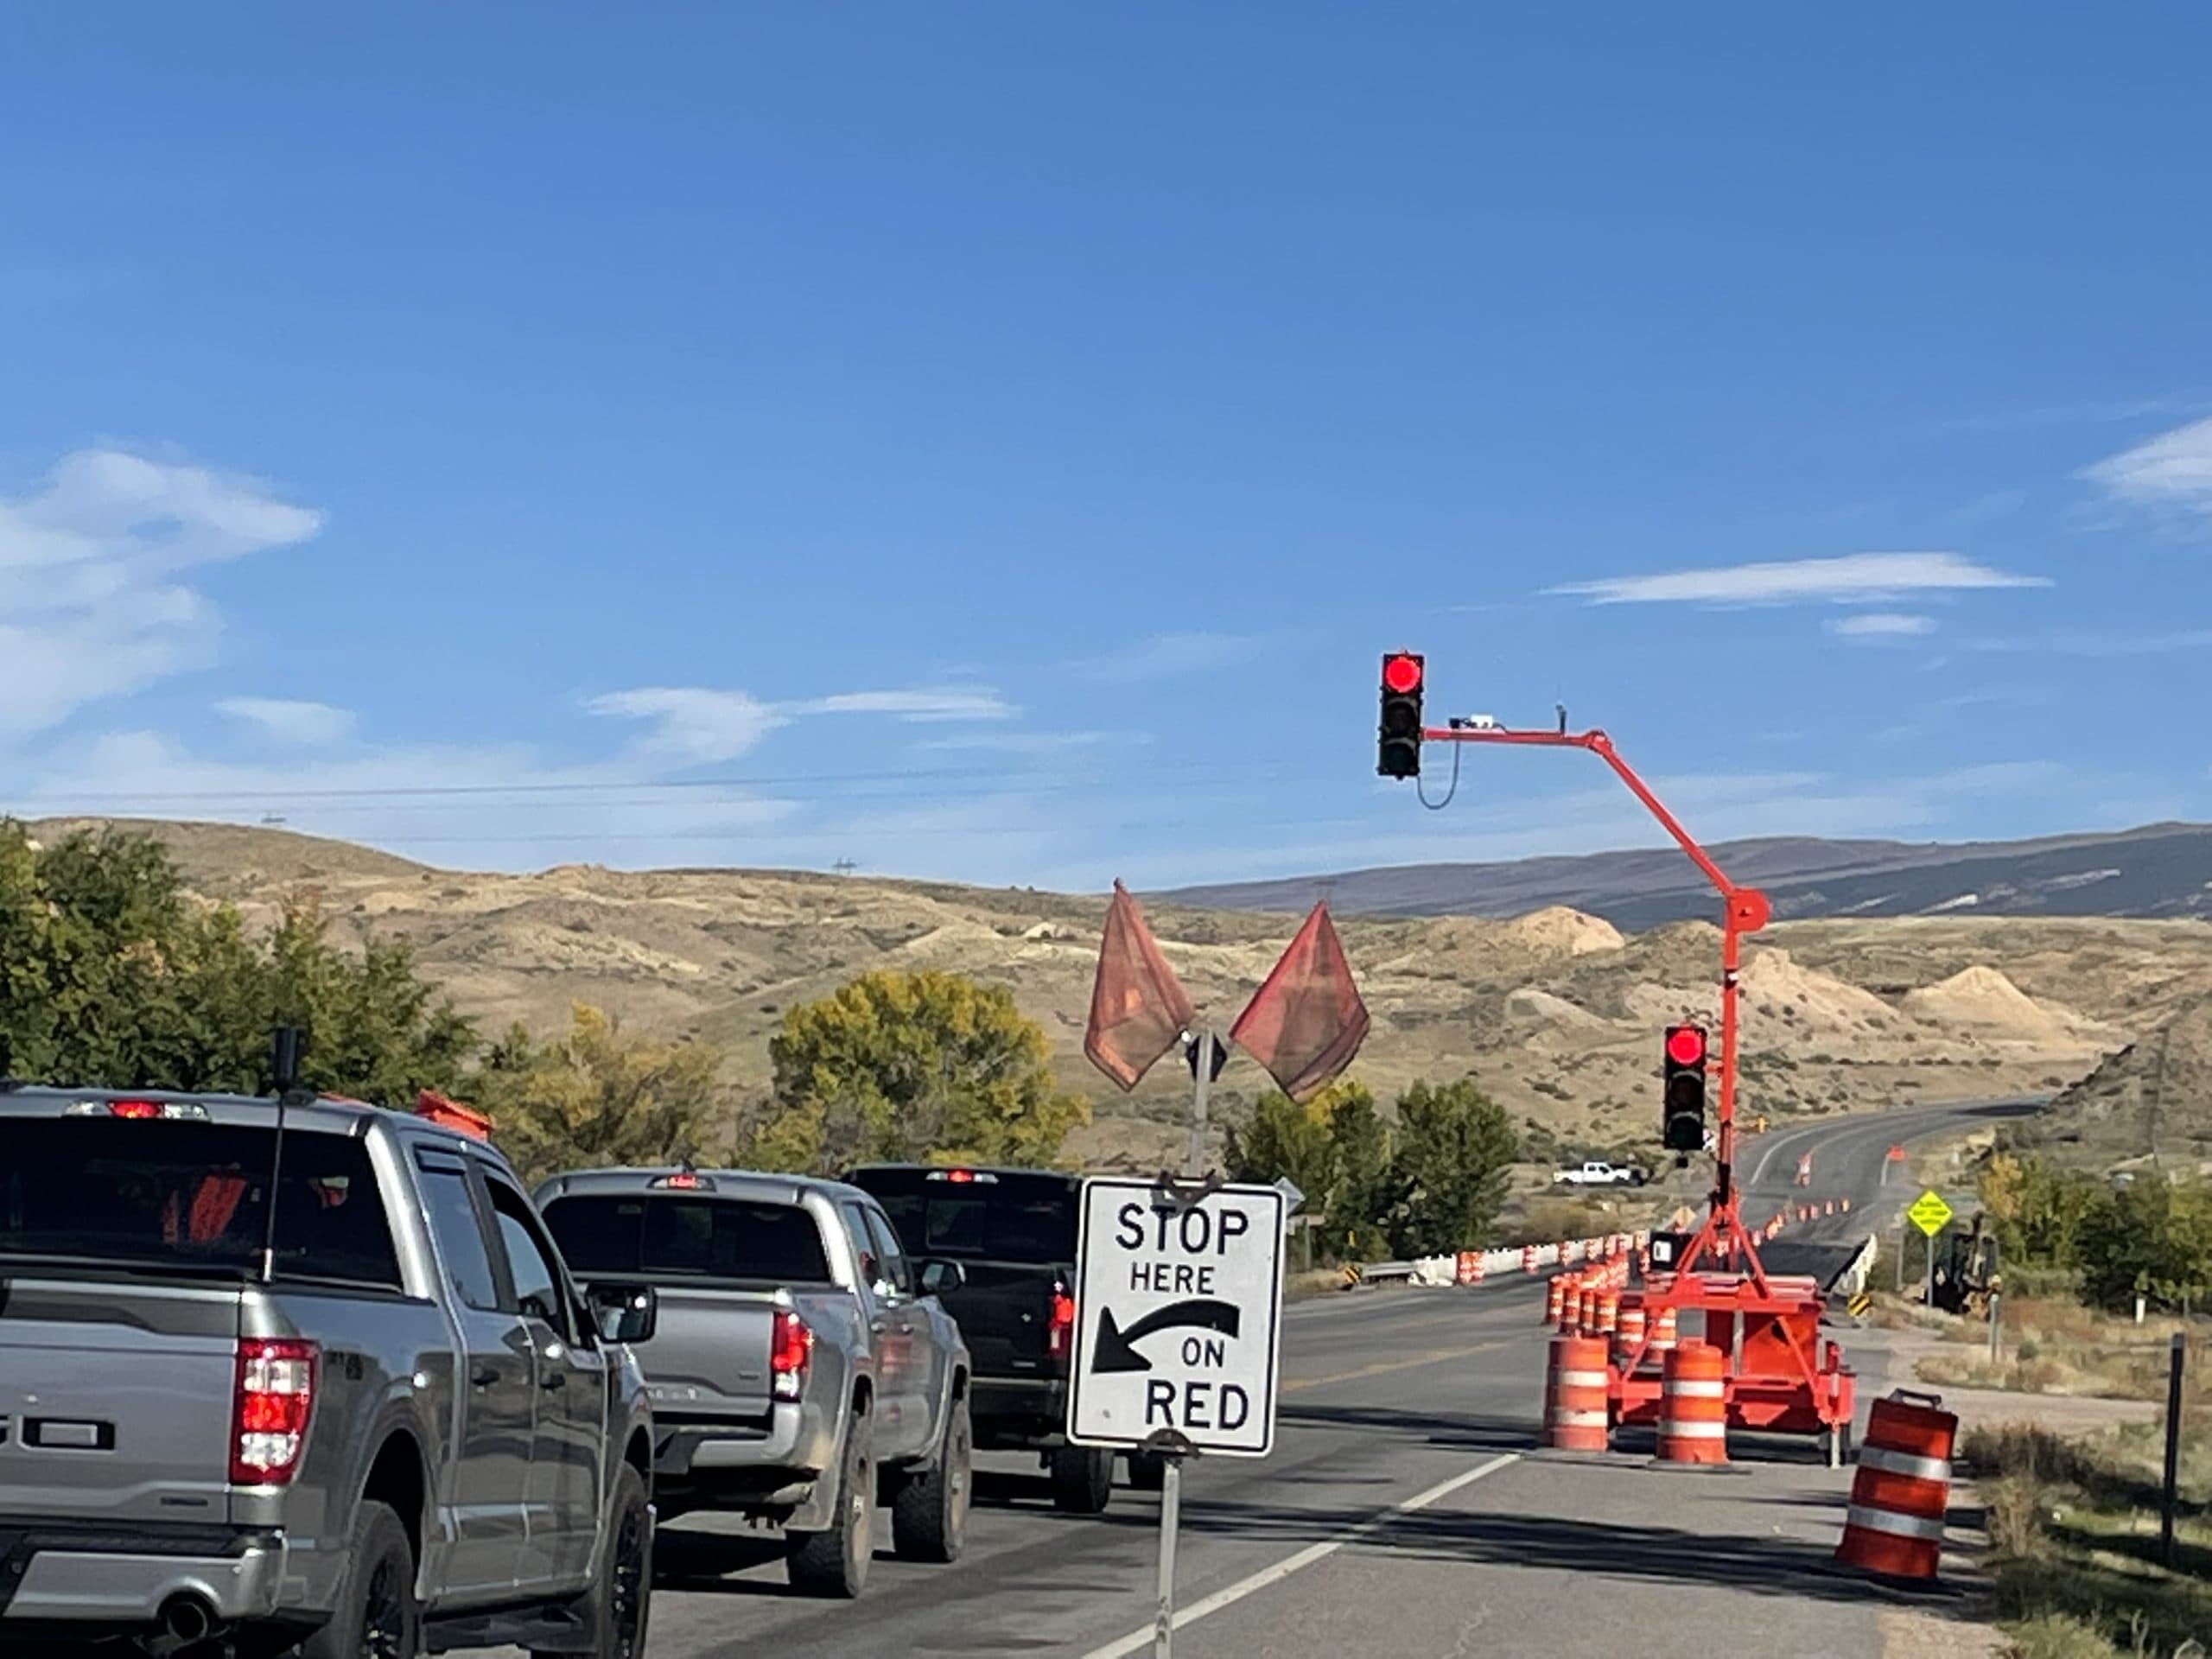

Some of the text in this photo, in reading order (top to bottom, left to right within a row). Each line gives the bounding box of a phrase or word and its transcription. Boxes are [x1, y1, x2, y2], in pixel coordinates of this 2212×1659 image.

[1116, 1202, 1249, 1255] STOP
[1130, 1262, 1215, 1295] HERE
[1181, 1337, 1225, 1368] ON
[1145, 1379, 1249, 1431] RED
